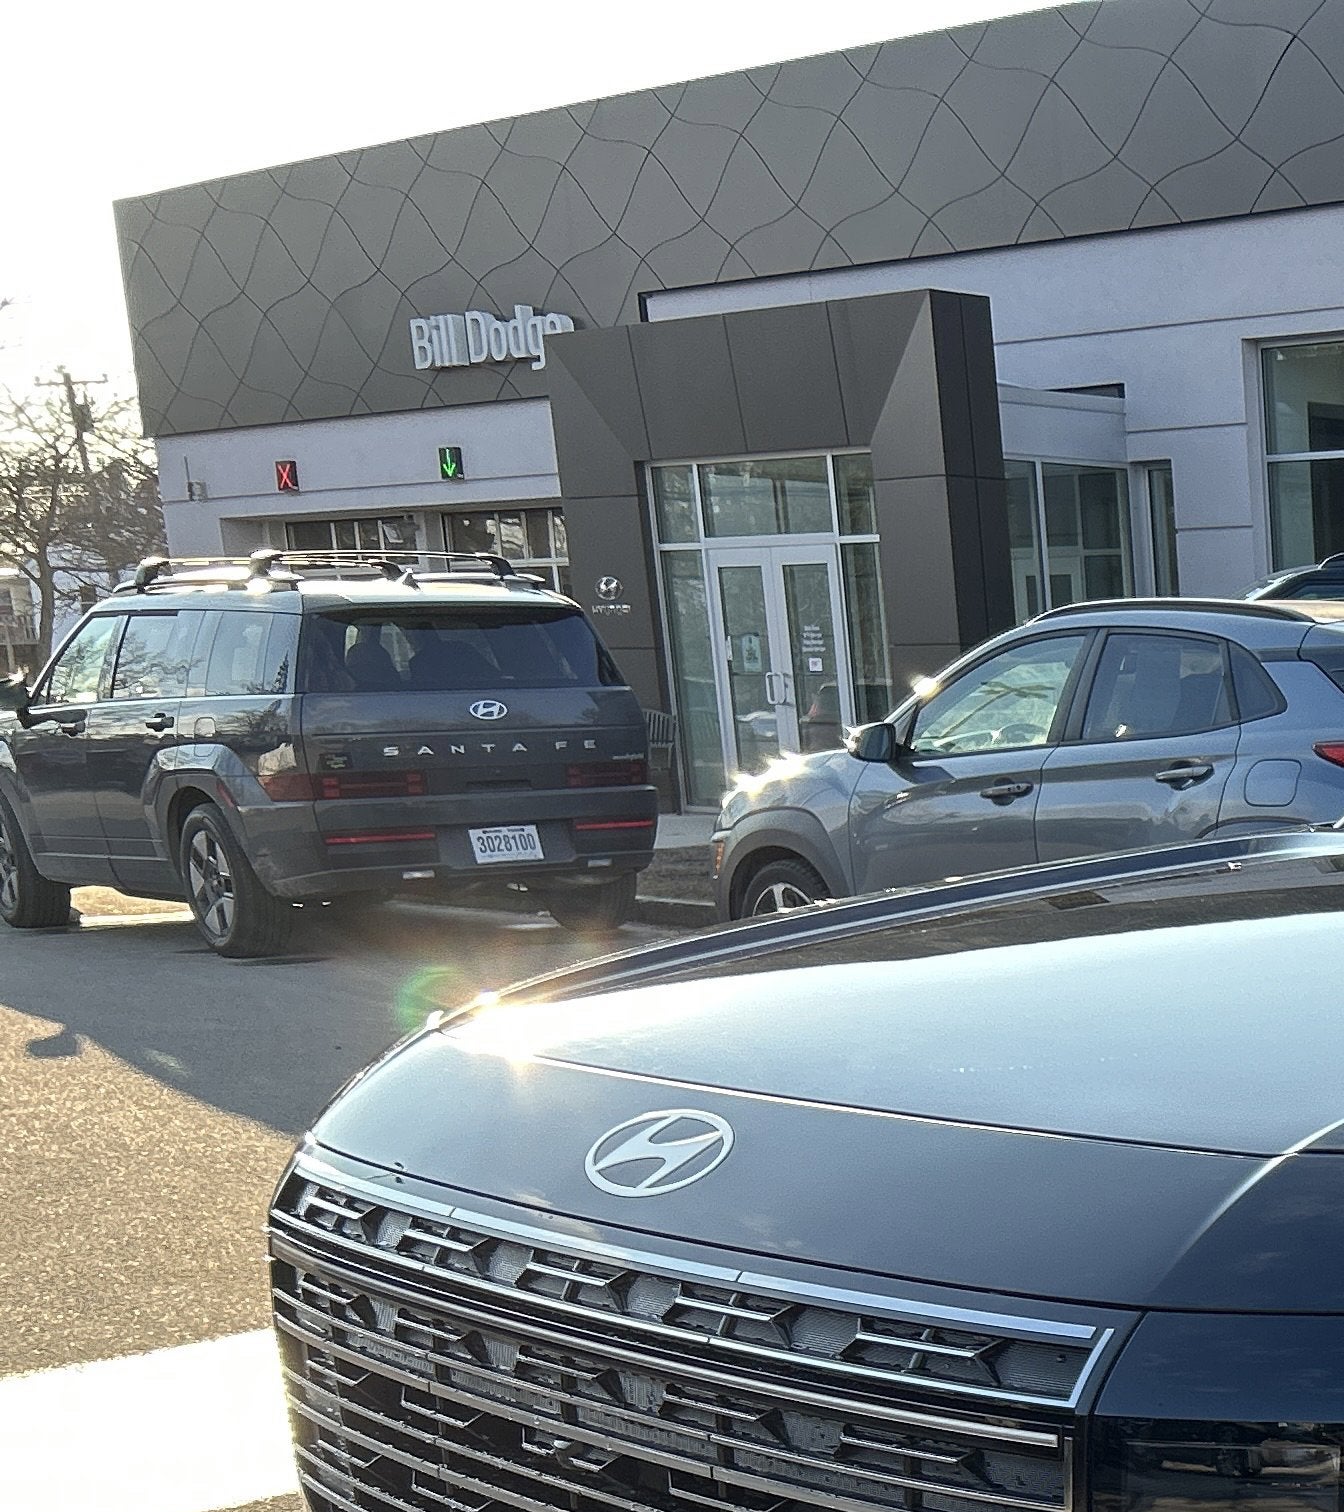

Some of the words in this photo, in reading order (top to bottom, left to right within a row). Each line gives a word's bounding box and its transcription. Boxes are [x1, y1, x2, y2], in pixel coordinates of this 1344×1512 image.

[410, 314, 470, 370] Bill
[383, 743, 528, 757] SANTA
[555, 738, 597, 751] FE
[477, 833, 536, 853] 3028100
